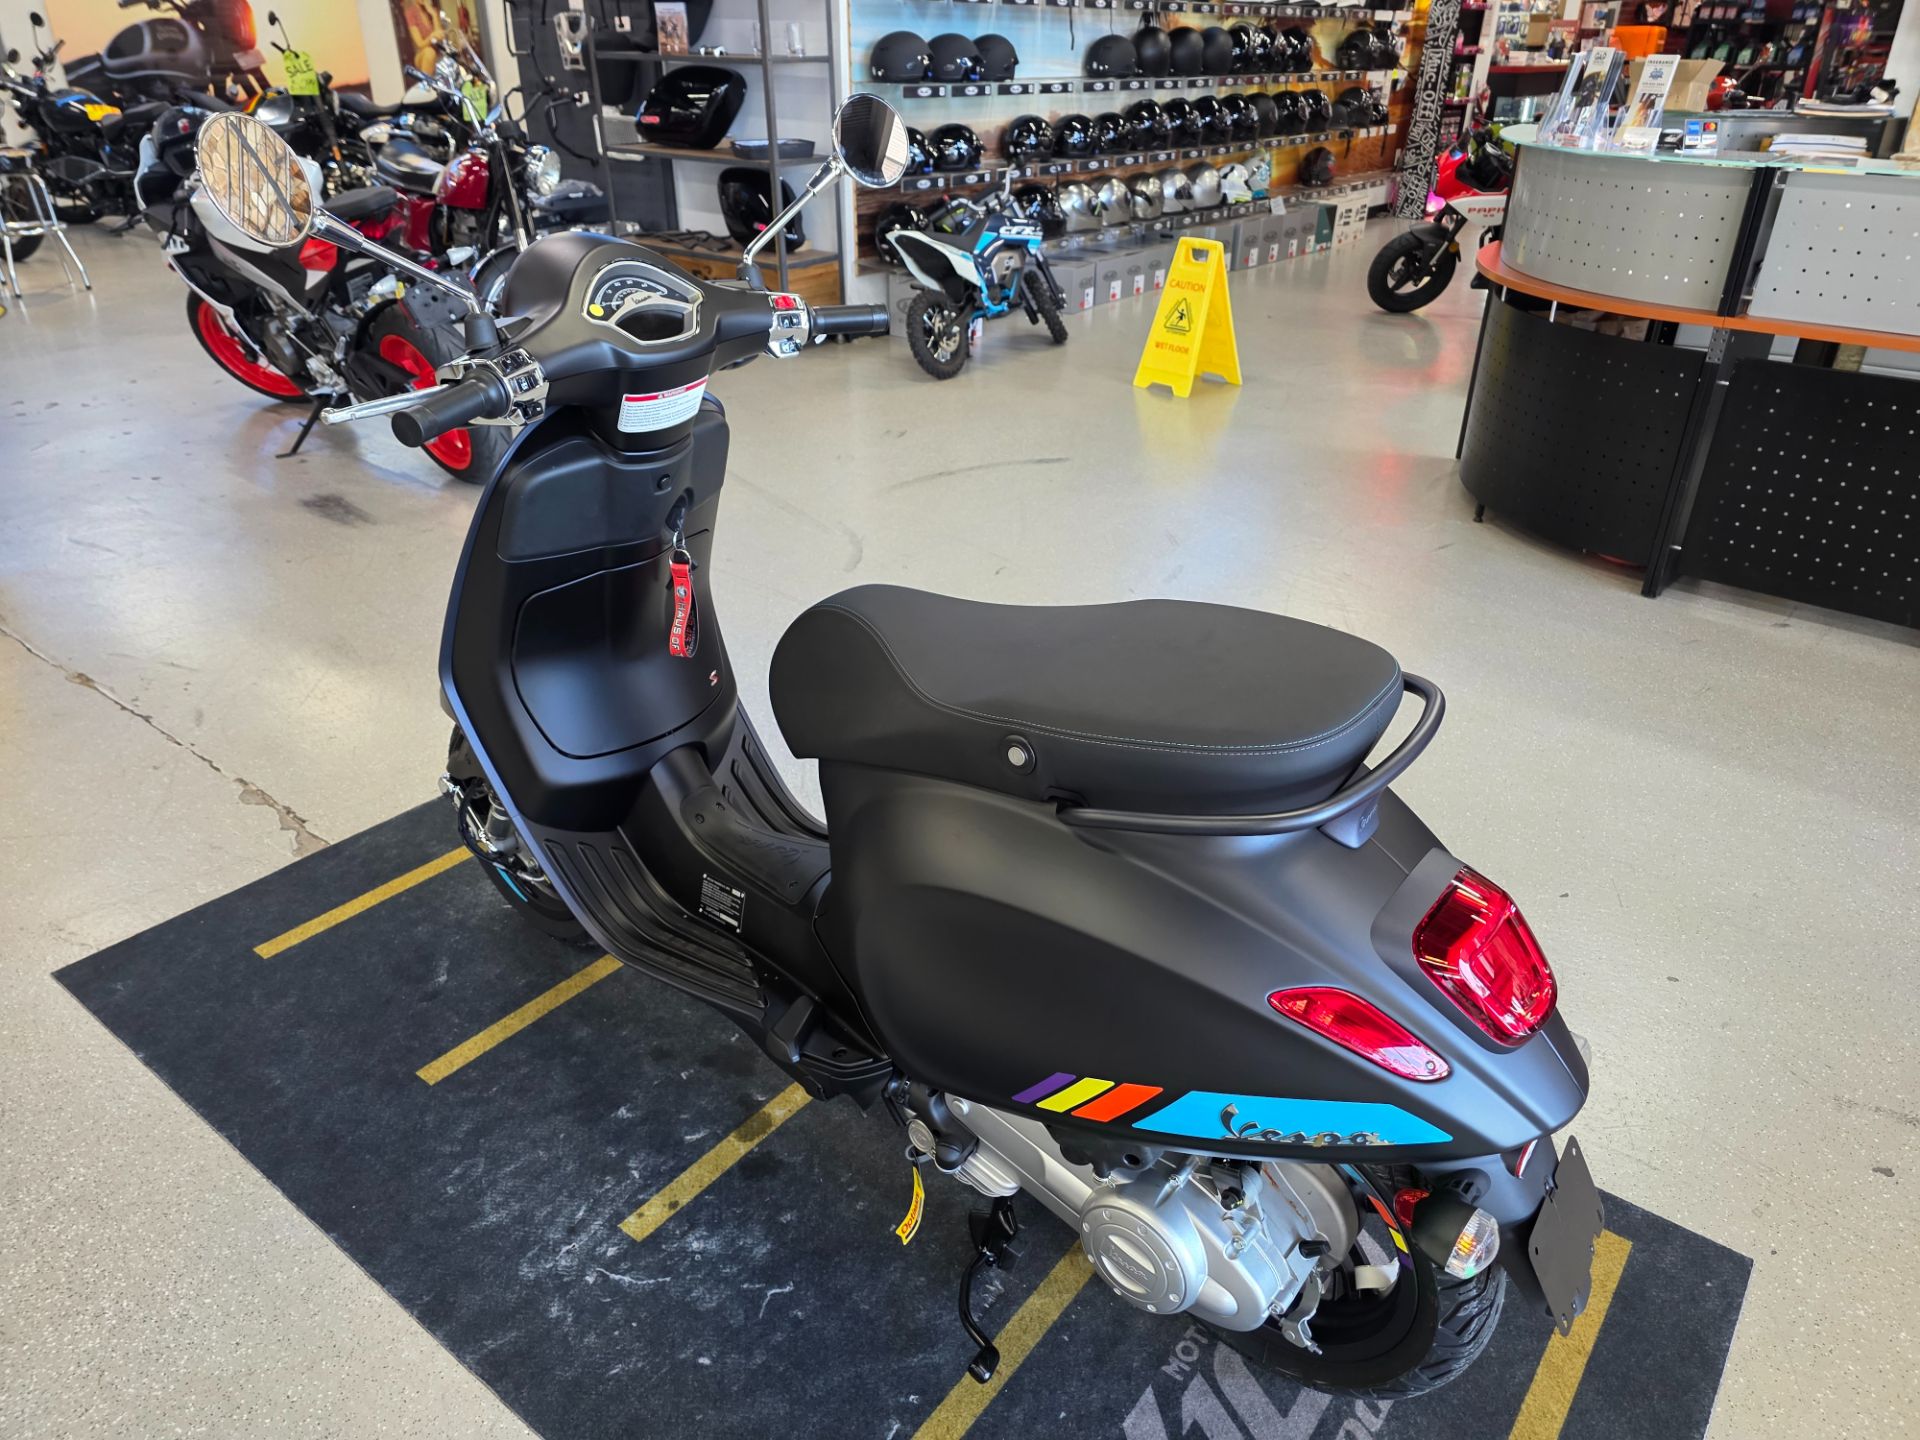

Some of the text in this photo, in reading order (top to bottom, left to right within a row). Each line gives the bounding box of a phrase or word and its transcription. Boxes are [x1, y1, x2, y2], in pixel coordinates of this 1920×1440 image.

[285, 59, 313, 78] SALE
[1169, 278, 1207, 294] CAUTION
[1155, 340, 1190, 355] WET FLOOR
[673, 602, 687, 635] HAUS
[1220, 1102, 1397, 1148] Vespa
